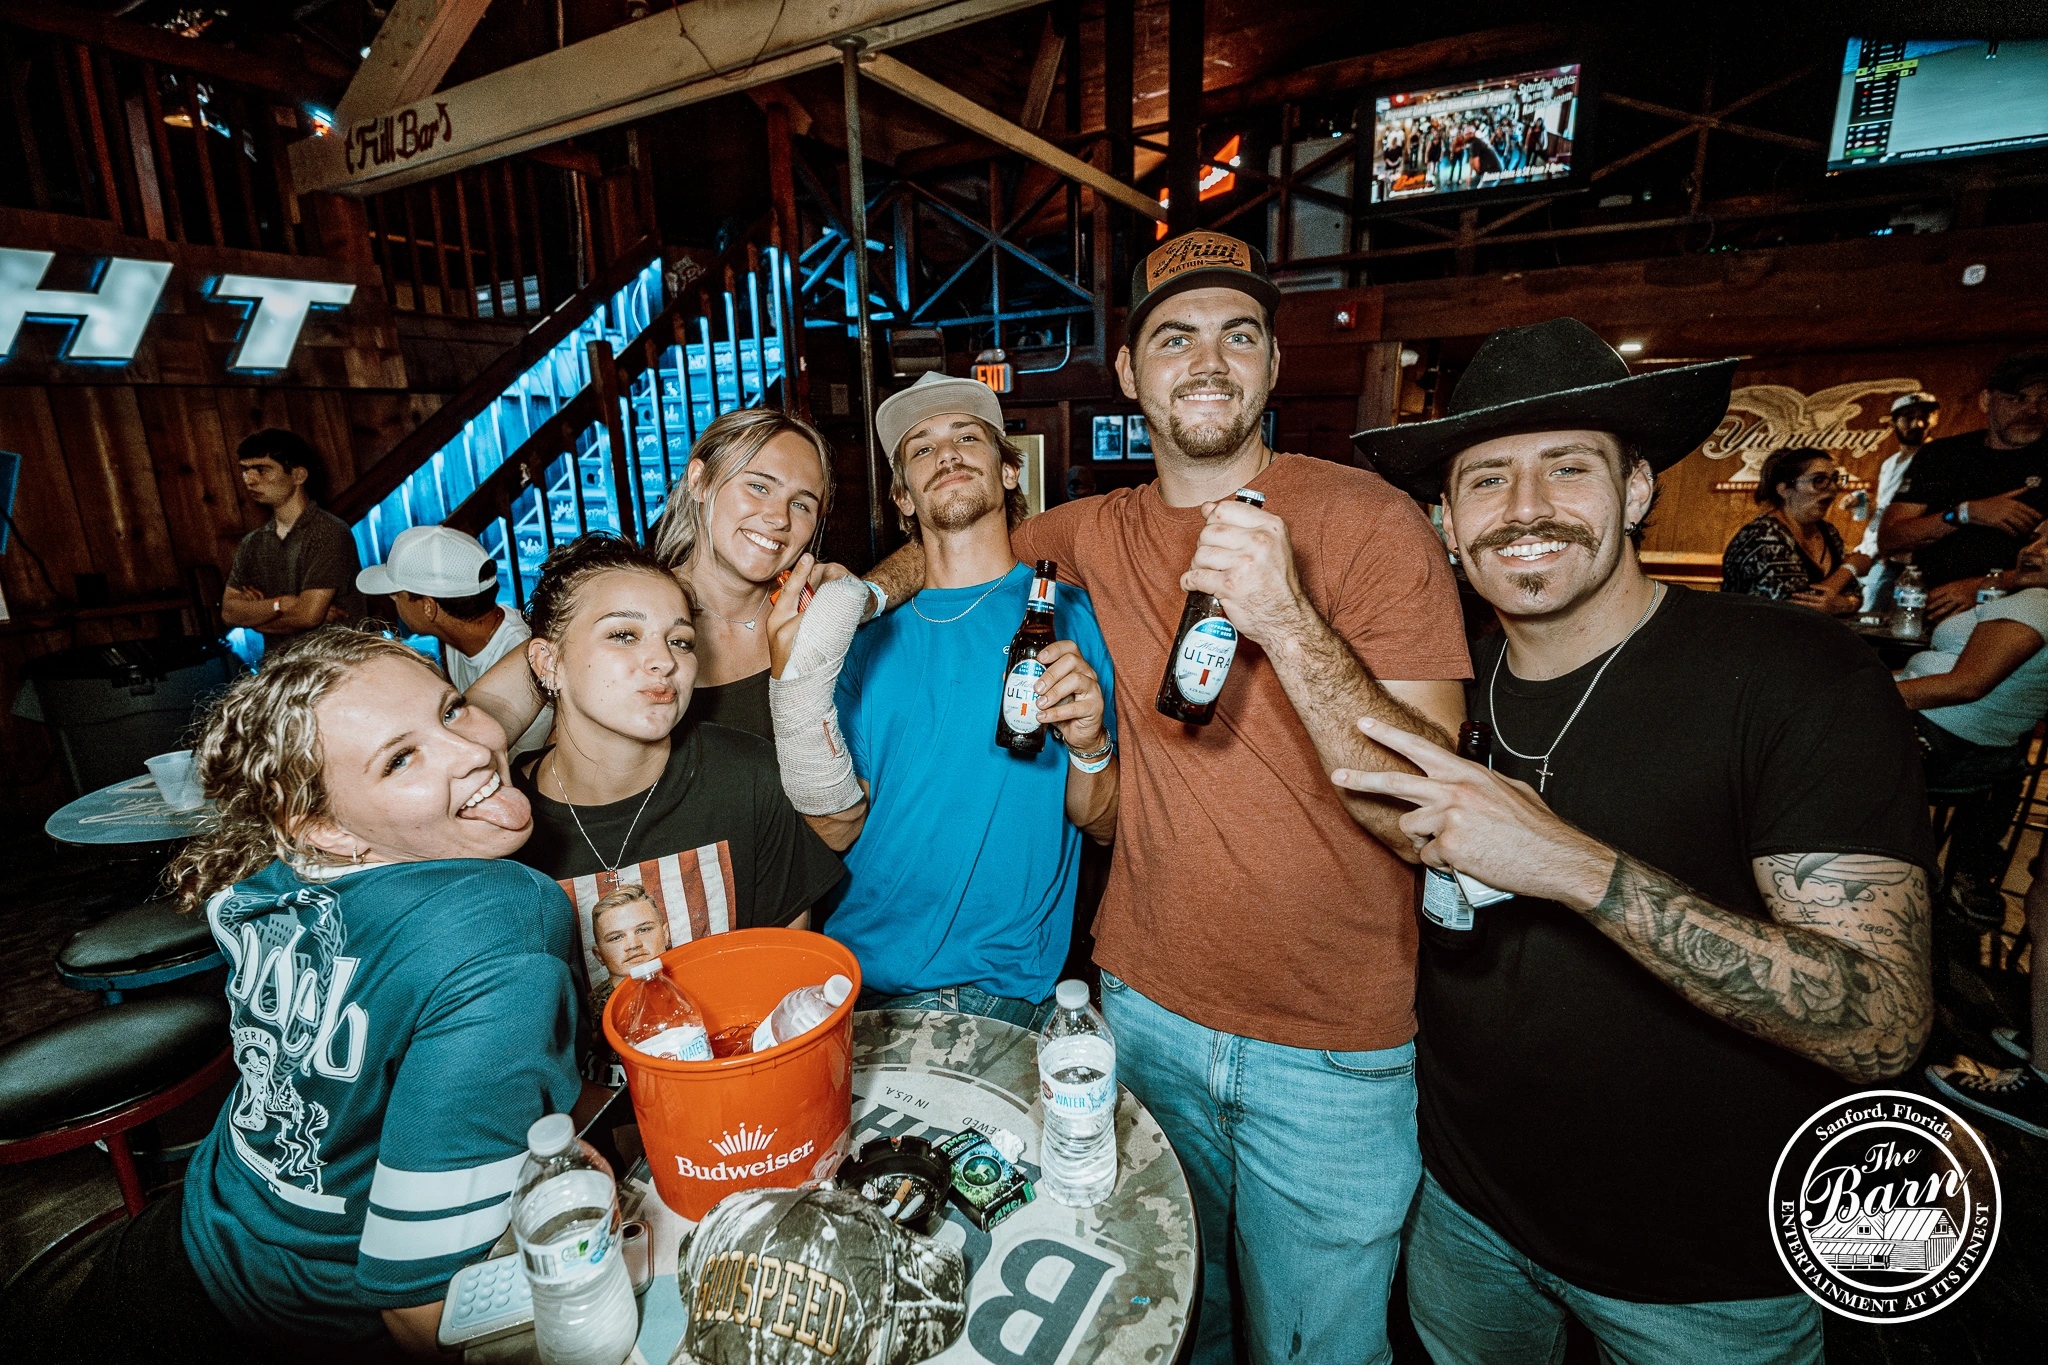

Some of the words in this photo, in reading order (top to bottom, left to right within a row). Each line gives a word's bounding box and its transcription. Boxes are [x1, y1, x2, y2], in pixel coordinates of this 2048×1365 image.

[356, 118, 396, 169] Full
[396, 109, 440, 158] Bar
[1168, 260, 1204, 274] NATION
[977, 364, 1006, 392] EXIT
[1183, 646, 1231, 669] ULTRA
[1007, 686, 1041, 701] ULTR
[678, 1040, 706, 1061] WATER
[885, 1085, 914, 1104] U.S.A.
[914, 1098, 931, 1110] IN
[1054, 1092, 1085, 1109] WATER
[940, 1132, 978, 1153] AMEL
[988, 1199, 1024, 1228] CAMEL
[693, 1250, 848, 1357] GODSPEED
